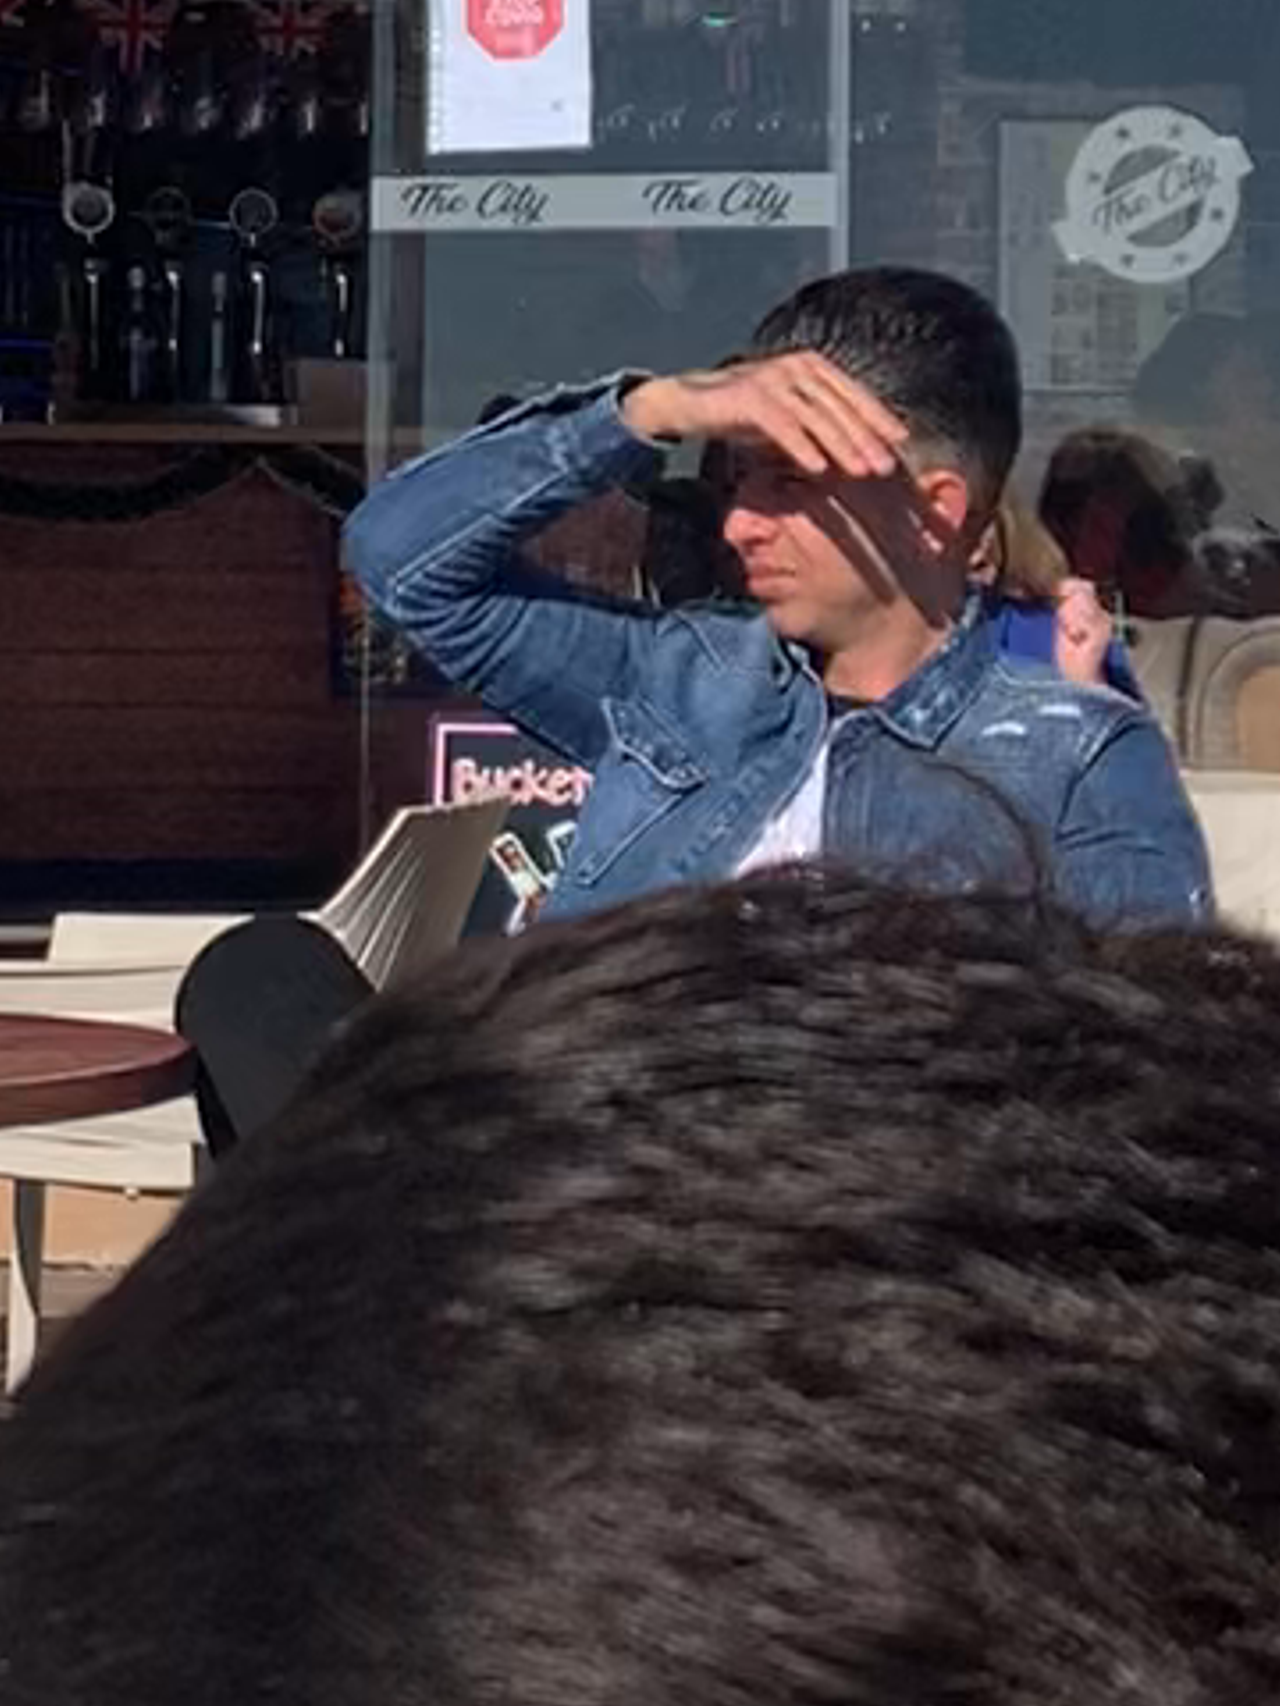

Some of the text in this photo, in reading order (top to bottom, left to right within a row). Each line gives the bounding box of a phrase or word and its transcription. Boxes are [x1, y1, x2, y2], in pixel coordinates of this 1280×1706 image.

[399, 179, 550, 225] The City
[641, 176, 794, 224] The City
